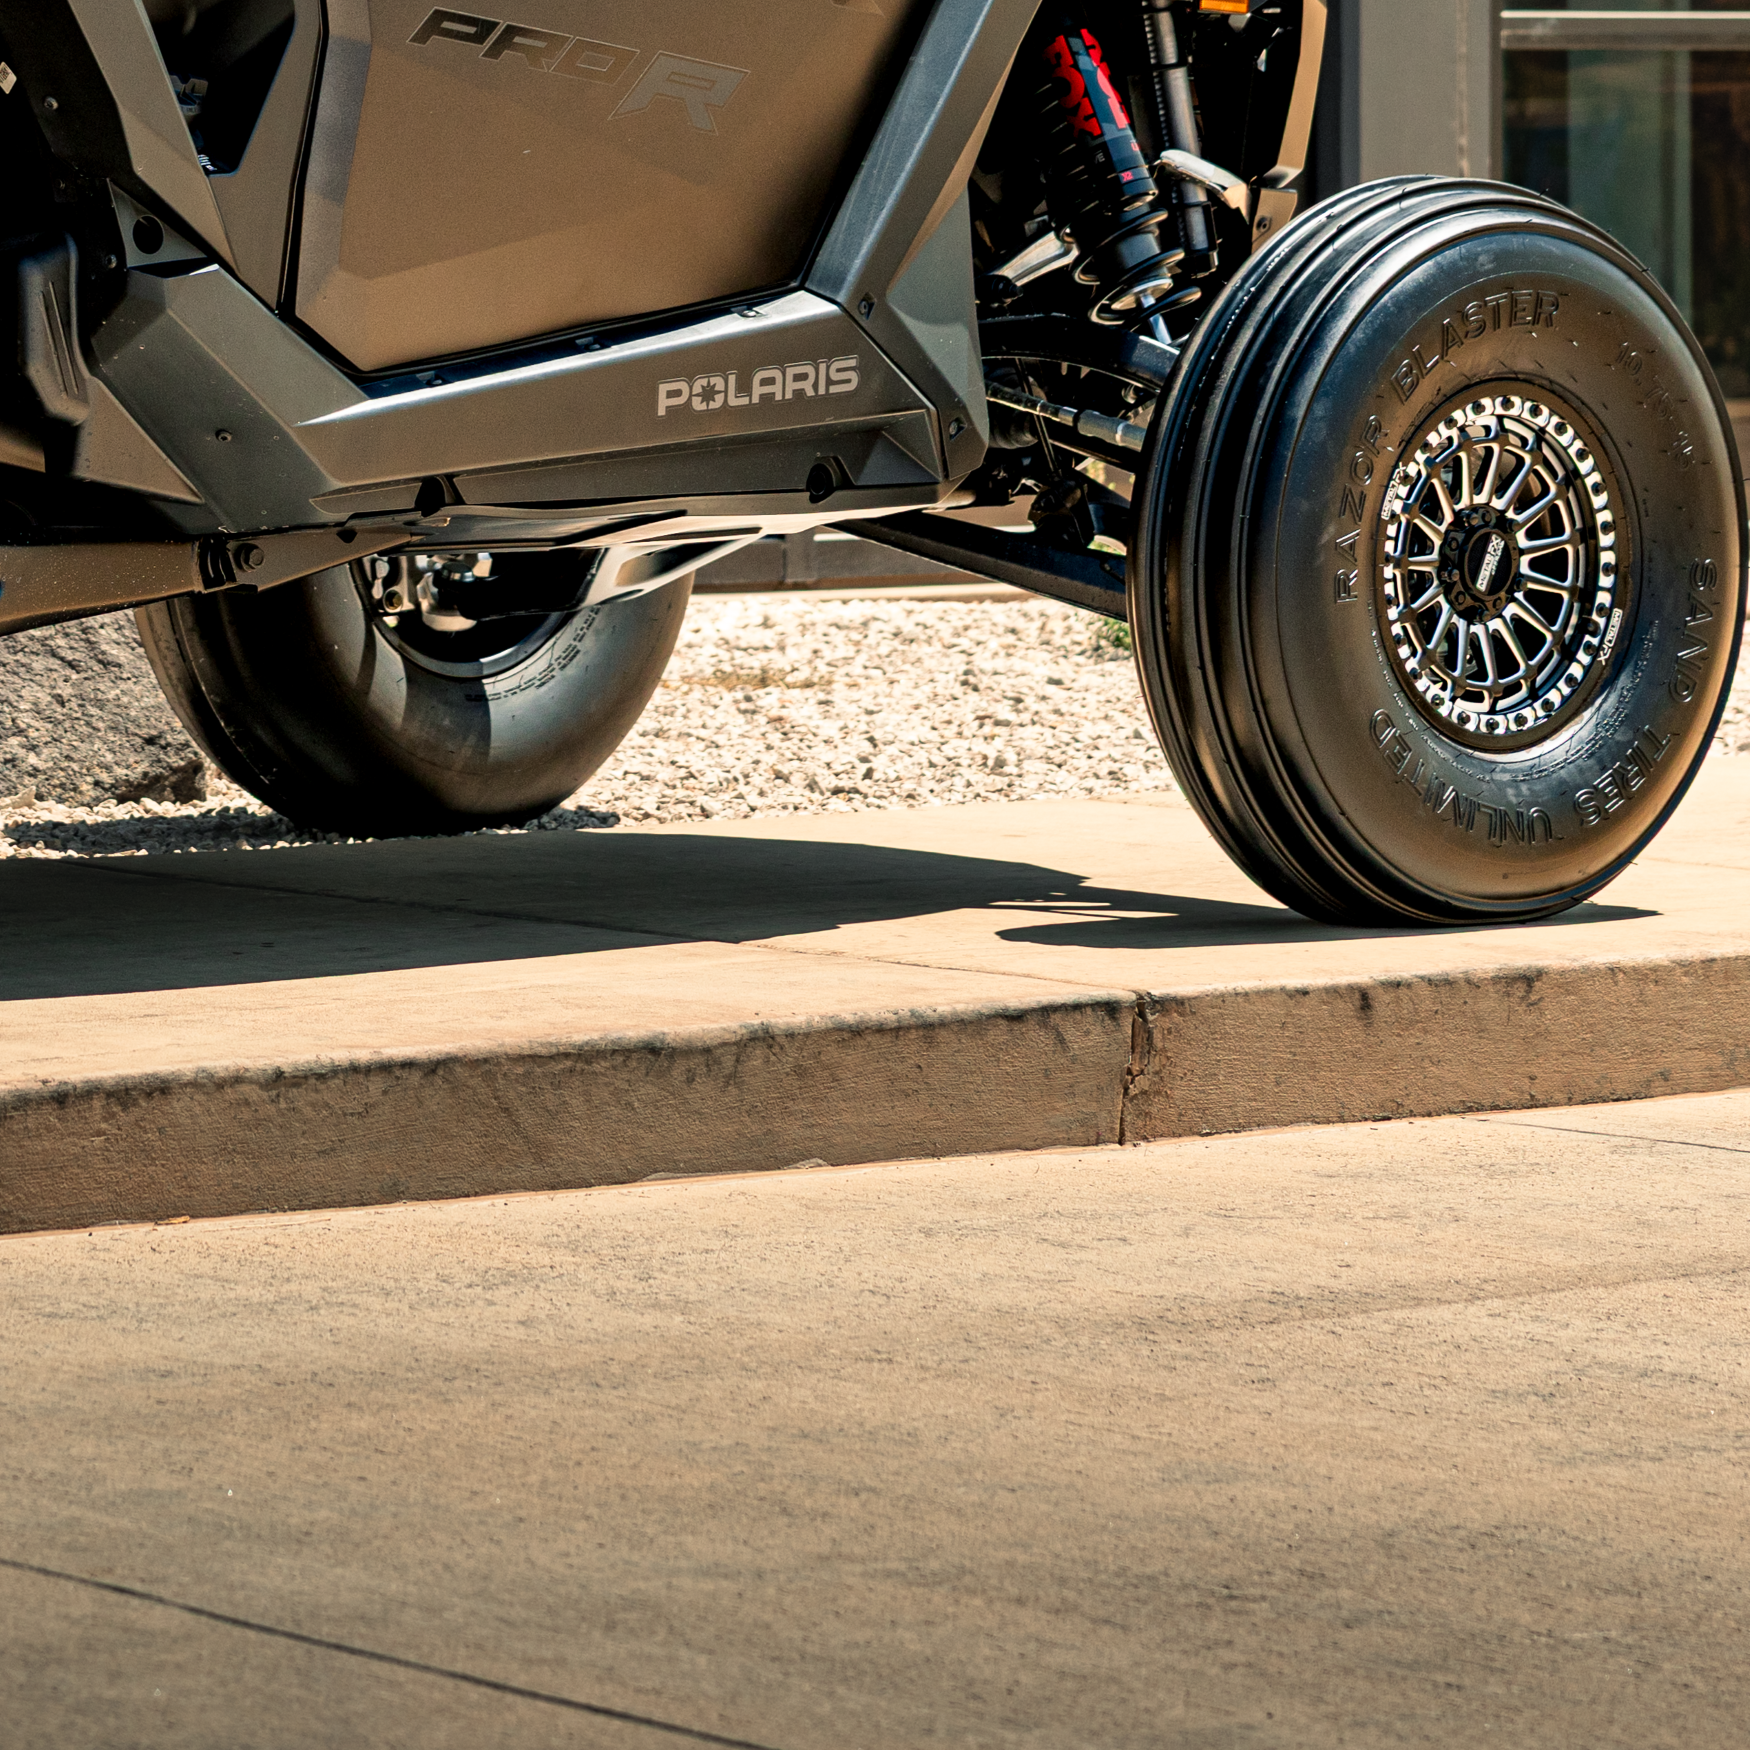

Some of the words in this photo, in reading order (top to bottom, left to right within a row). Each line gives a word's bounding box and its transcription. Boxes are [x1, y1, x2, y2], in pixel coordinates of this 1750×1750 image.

[407, 6, 640, 86] PRO
[609, 51, 749, 133] R
[655, 354, 860, 417] POLARIS
[1334, 415, 1391, 604] RAZOR
[1392, 290, 1560, 403] BLASTER
[1668, 558, 1717, 703] SAND
[1368, 708, 1553, 846] UNLIMITED
[1575, 723, 1673, 826] TIRES
